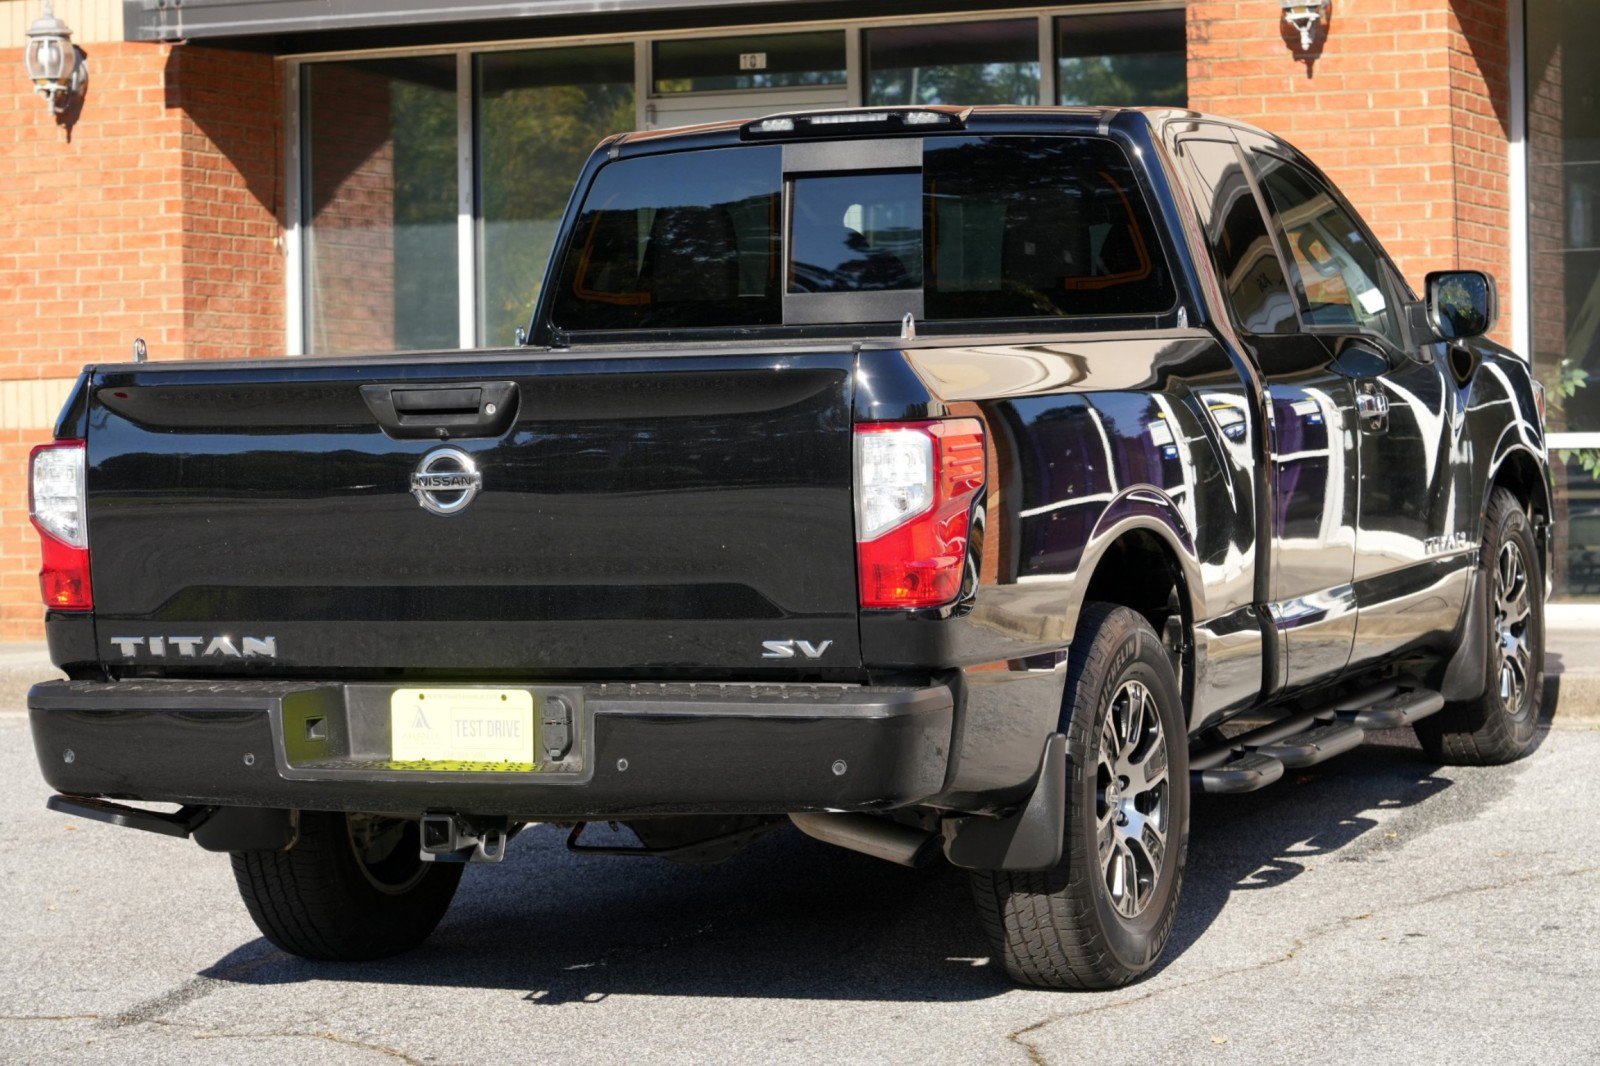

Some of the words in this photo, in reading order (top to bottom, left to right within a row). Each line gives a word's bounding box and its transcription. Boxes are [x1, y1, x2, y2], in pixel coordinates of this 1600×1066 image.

[419, 476, 471, 487] NISSAN
[110, 636, 277, 658] TITAN
[762, 639, 833, 658] SV
[1098, 638, 1137, 719] MICHELIN
[454, 719, 484, 737] TEST
[487, 719, 521, 738] DRIVE
